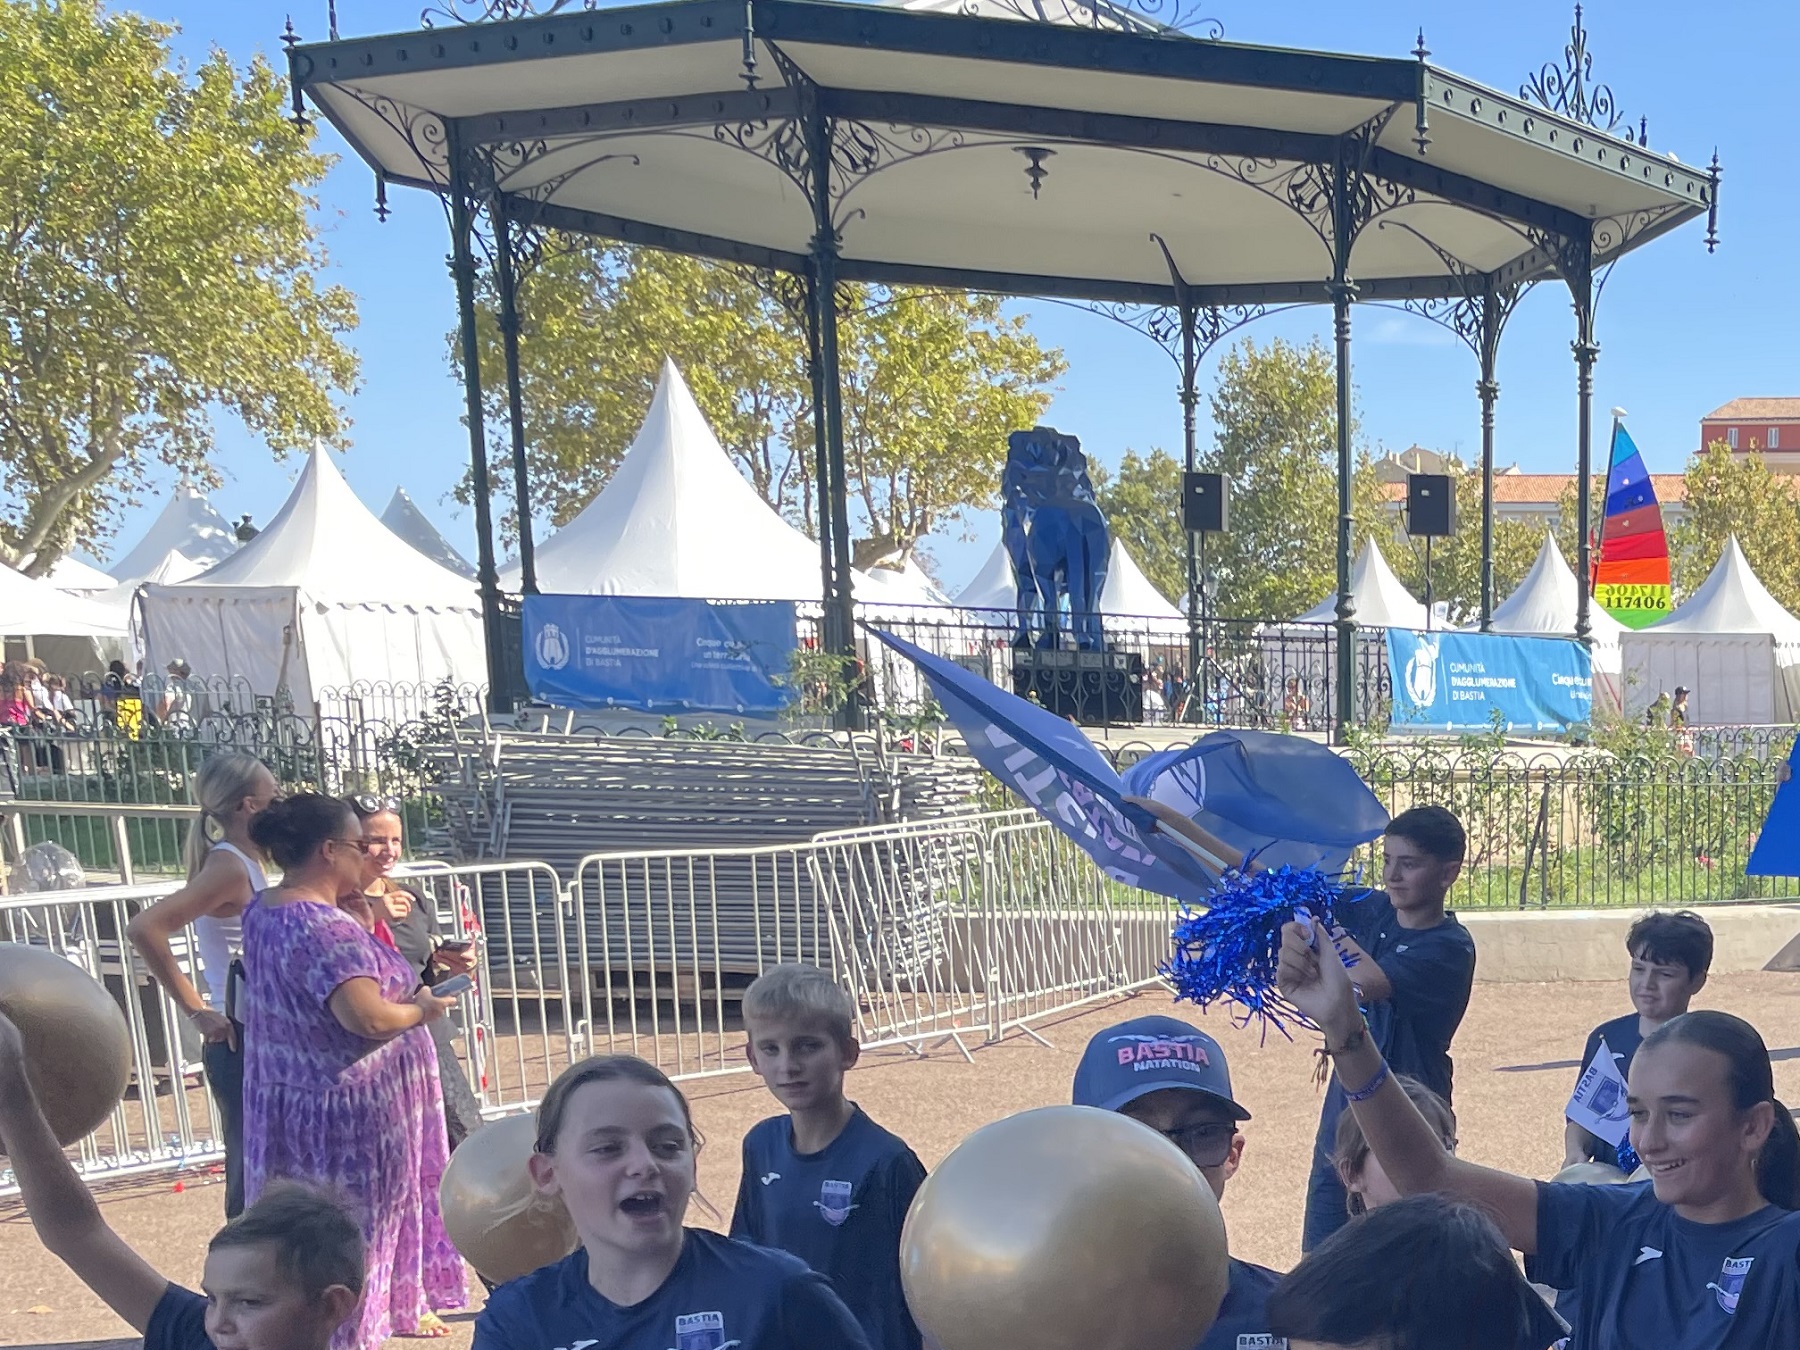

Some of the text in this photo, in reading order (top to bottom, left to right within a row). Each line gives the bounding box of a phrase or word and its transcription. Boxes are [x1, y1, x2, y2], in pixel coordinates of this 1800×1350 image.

[1606, 597, 1666, 609] 117406
[1450, 661, 1486, 673] CUMUNITÀ
[1461, 690, 1486, 701] BASTIA
[1118, 1042, 1210, 1067] BASTIA
[1134, 1058, 1201, 1073] NATATION
[679, 1314, 720, 1326] BASTIA
